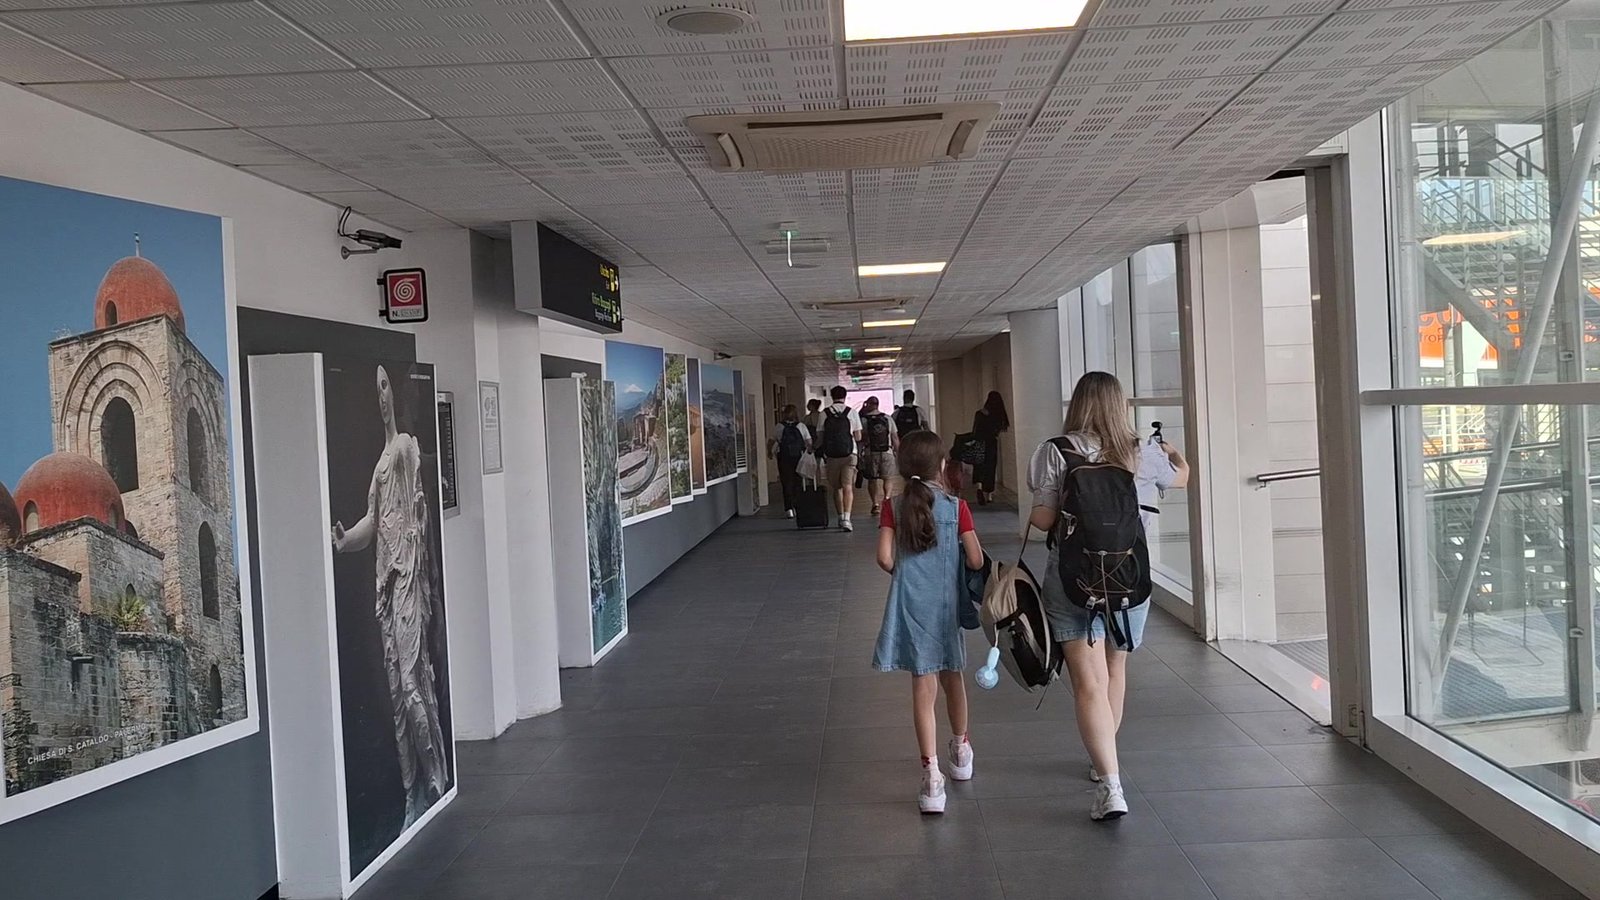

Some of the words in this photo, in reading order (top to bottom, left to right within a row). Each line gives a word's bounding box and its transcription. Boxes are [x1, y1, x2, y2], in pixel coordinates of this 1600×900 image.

[27, 750, 57, 765] CHIESA
[58, 747, 66, 756] DI
[76, 734, 109, 750] CATALDO
[114, 723, 147, 738] PALERMO
